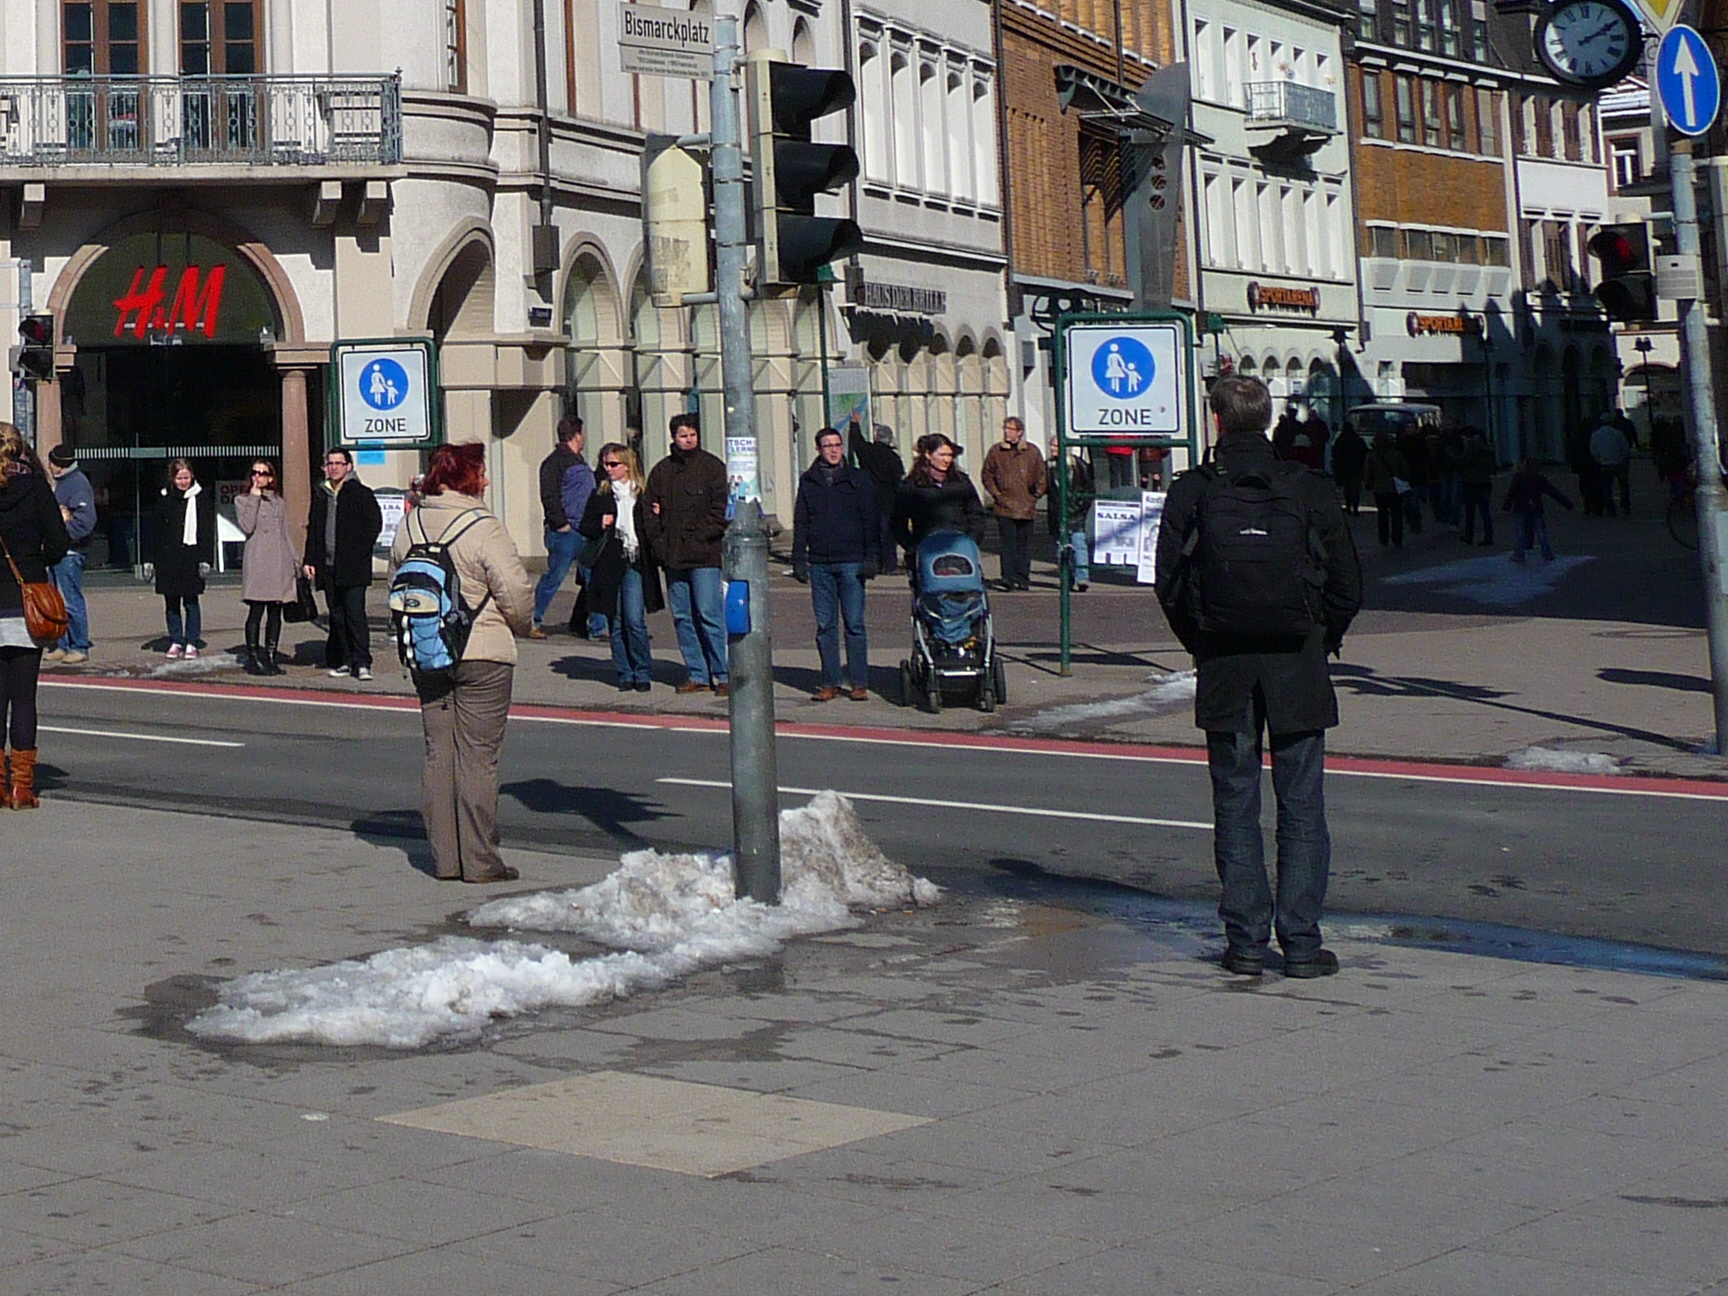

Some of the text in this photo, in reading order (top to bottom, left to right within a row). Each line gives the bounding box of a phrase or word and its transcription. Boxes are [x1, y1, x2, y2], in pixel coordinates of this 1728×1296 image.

[624, 10, 710, 48] Bismarckplatz
[113, 265, 226, 339] H&M
[864, 282, 891, 308] HAUS
[1419, 315, 1467, 333] SPORTARE
[365, 418, 407, 433] ZONE
[1098, 408, 1152, 425] ZONE
[1097, 512, 1137, 521] SALSA
